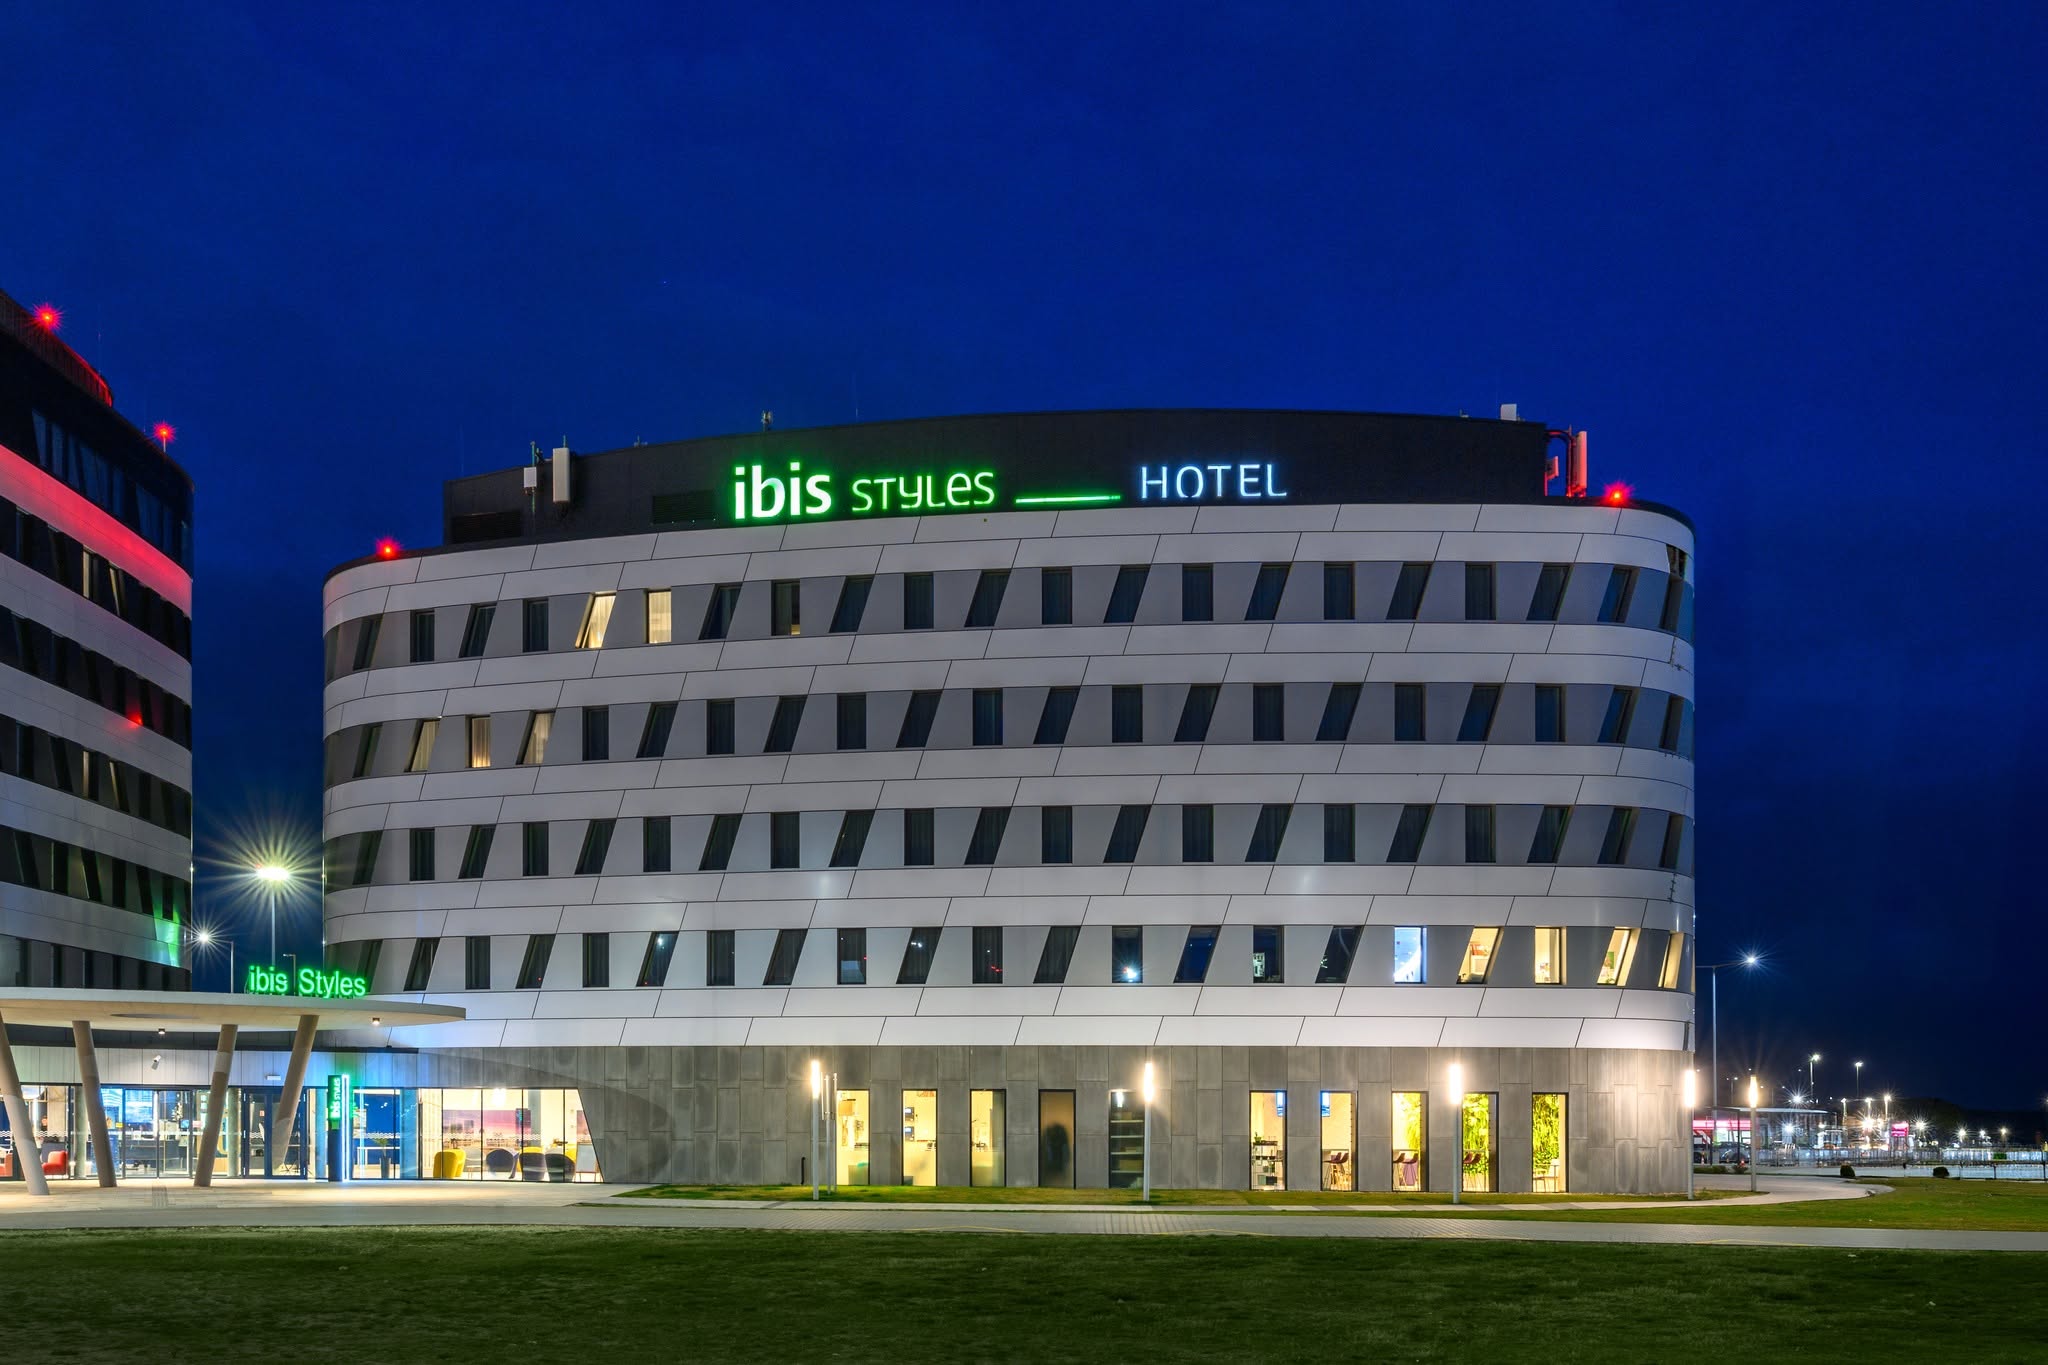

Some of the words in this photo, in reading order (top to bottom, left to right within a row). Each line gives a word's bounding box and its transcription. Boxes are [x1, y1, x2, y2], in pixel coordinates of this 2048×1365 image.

[735, 462, 832, 519] ibis
[1141, 464, 1288, 499] HOTEL
[249, 965, 289, 992] ibis
[298, 968, 366, 998] Styles
